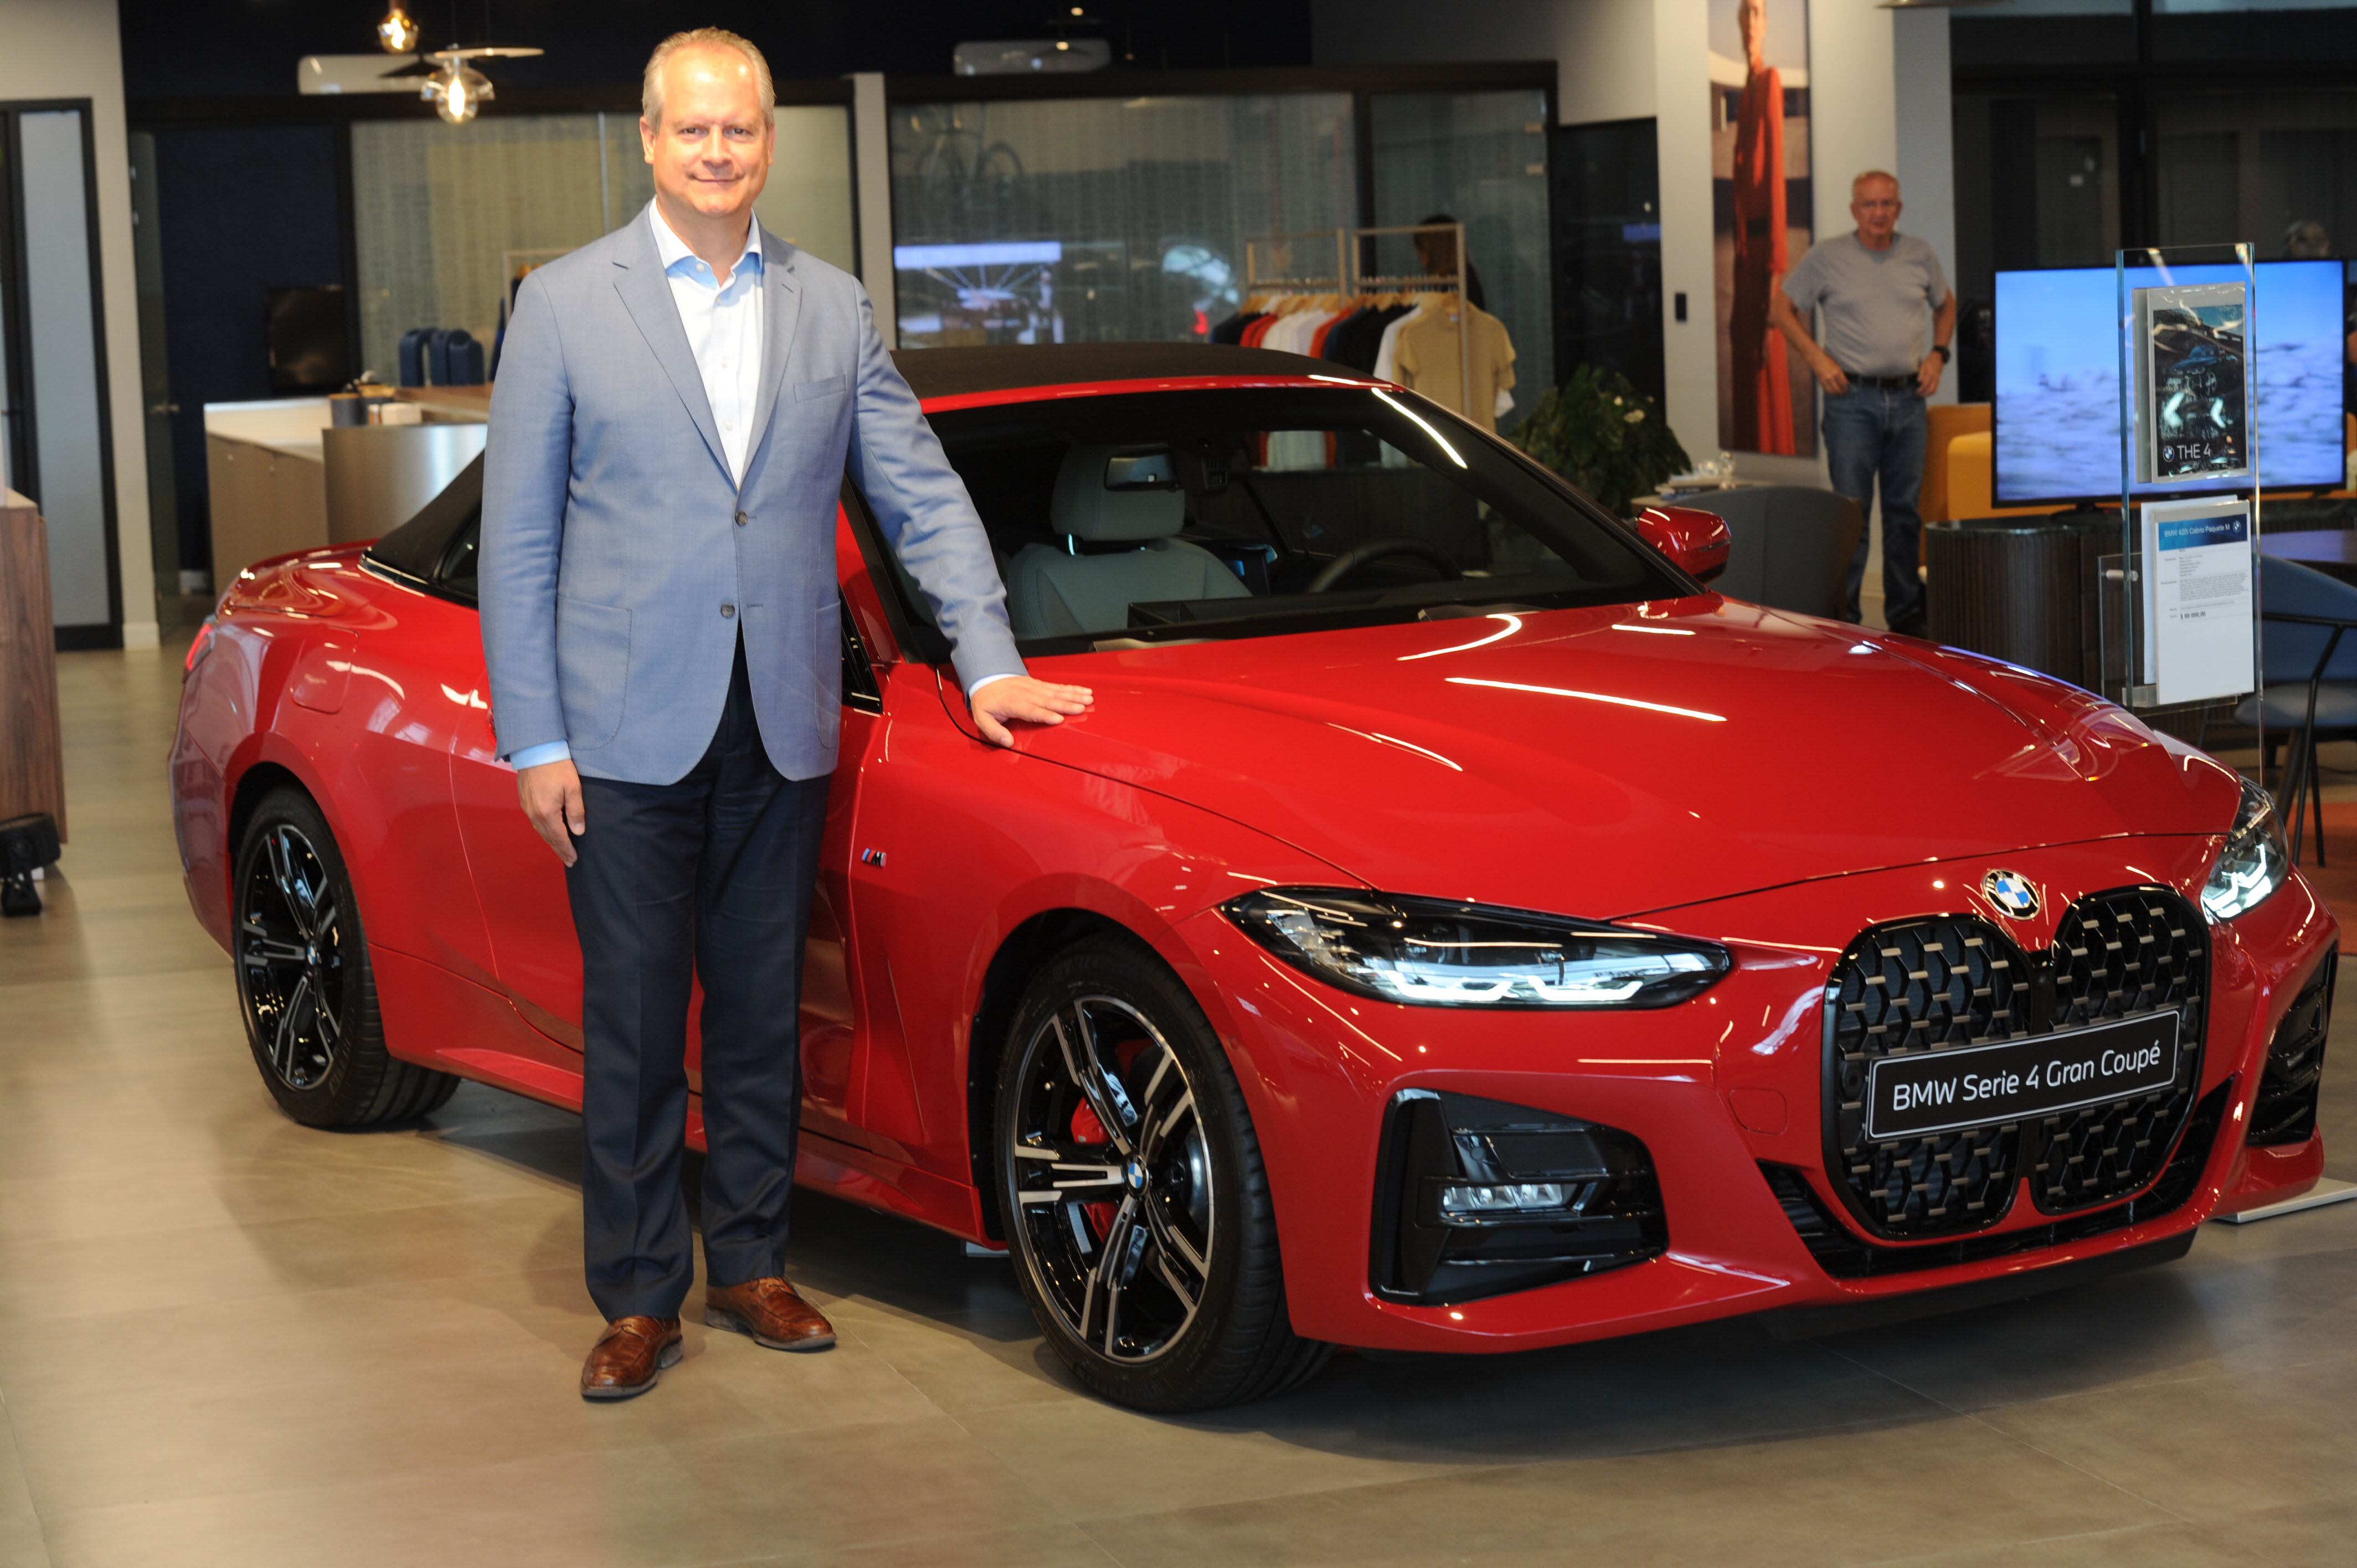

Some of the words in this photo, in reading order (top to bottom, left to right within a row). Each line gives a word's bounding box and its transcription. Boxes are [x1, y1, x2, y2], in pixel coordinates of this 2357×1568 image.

[2176, 442, 2201, 460] THE
[2203, 442, 2211, 457] 4
[1893, 1077, 1957, 1111] BMW
[1962, 1070, 2020, 1102] Serie
[2025, 1064, 2040, 1090] 4
[2046, 1060, 2095, 1087] Gran
[2101, 1039, 2161, 1076] Coupé
